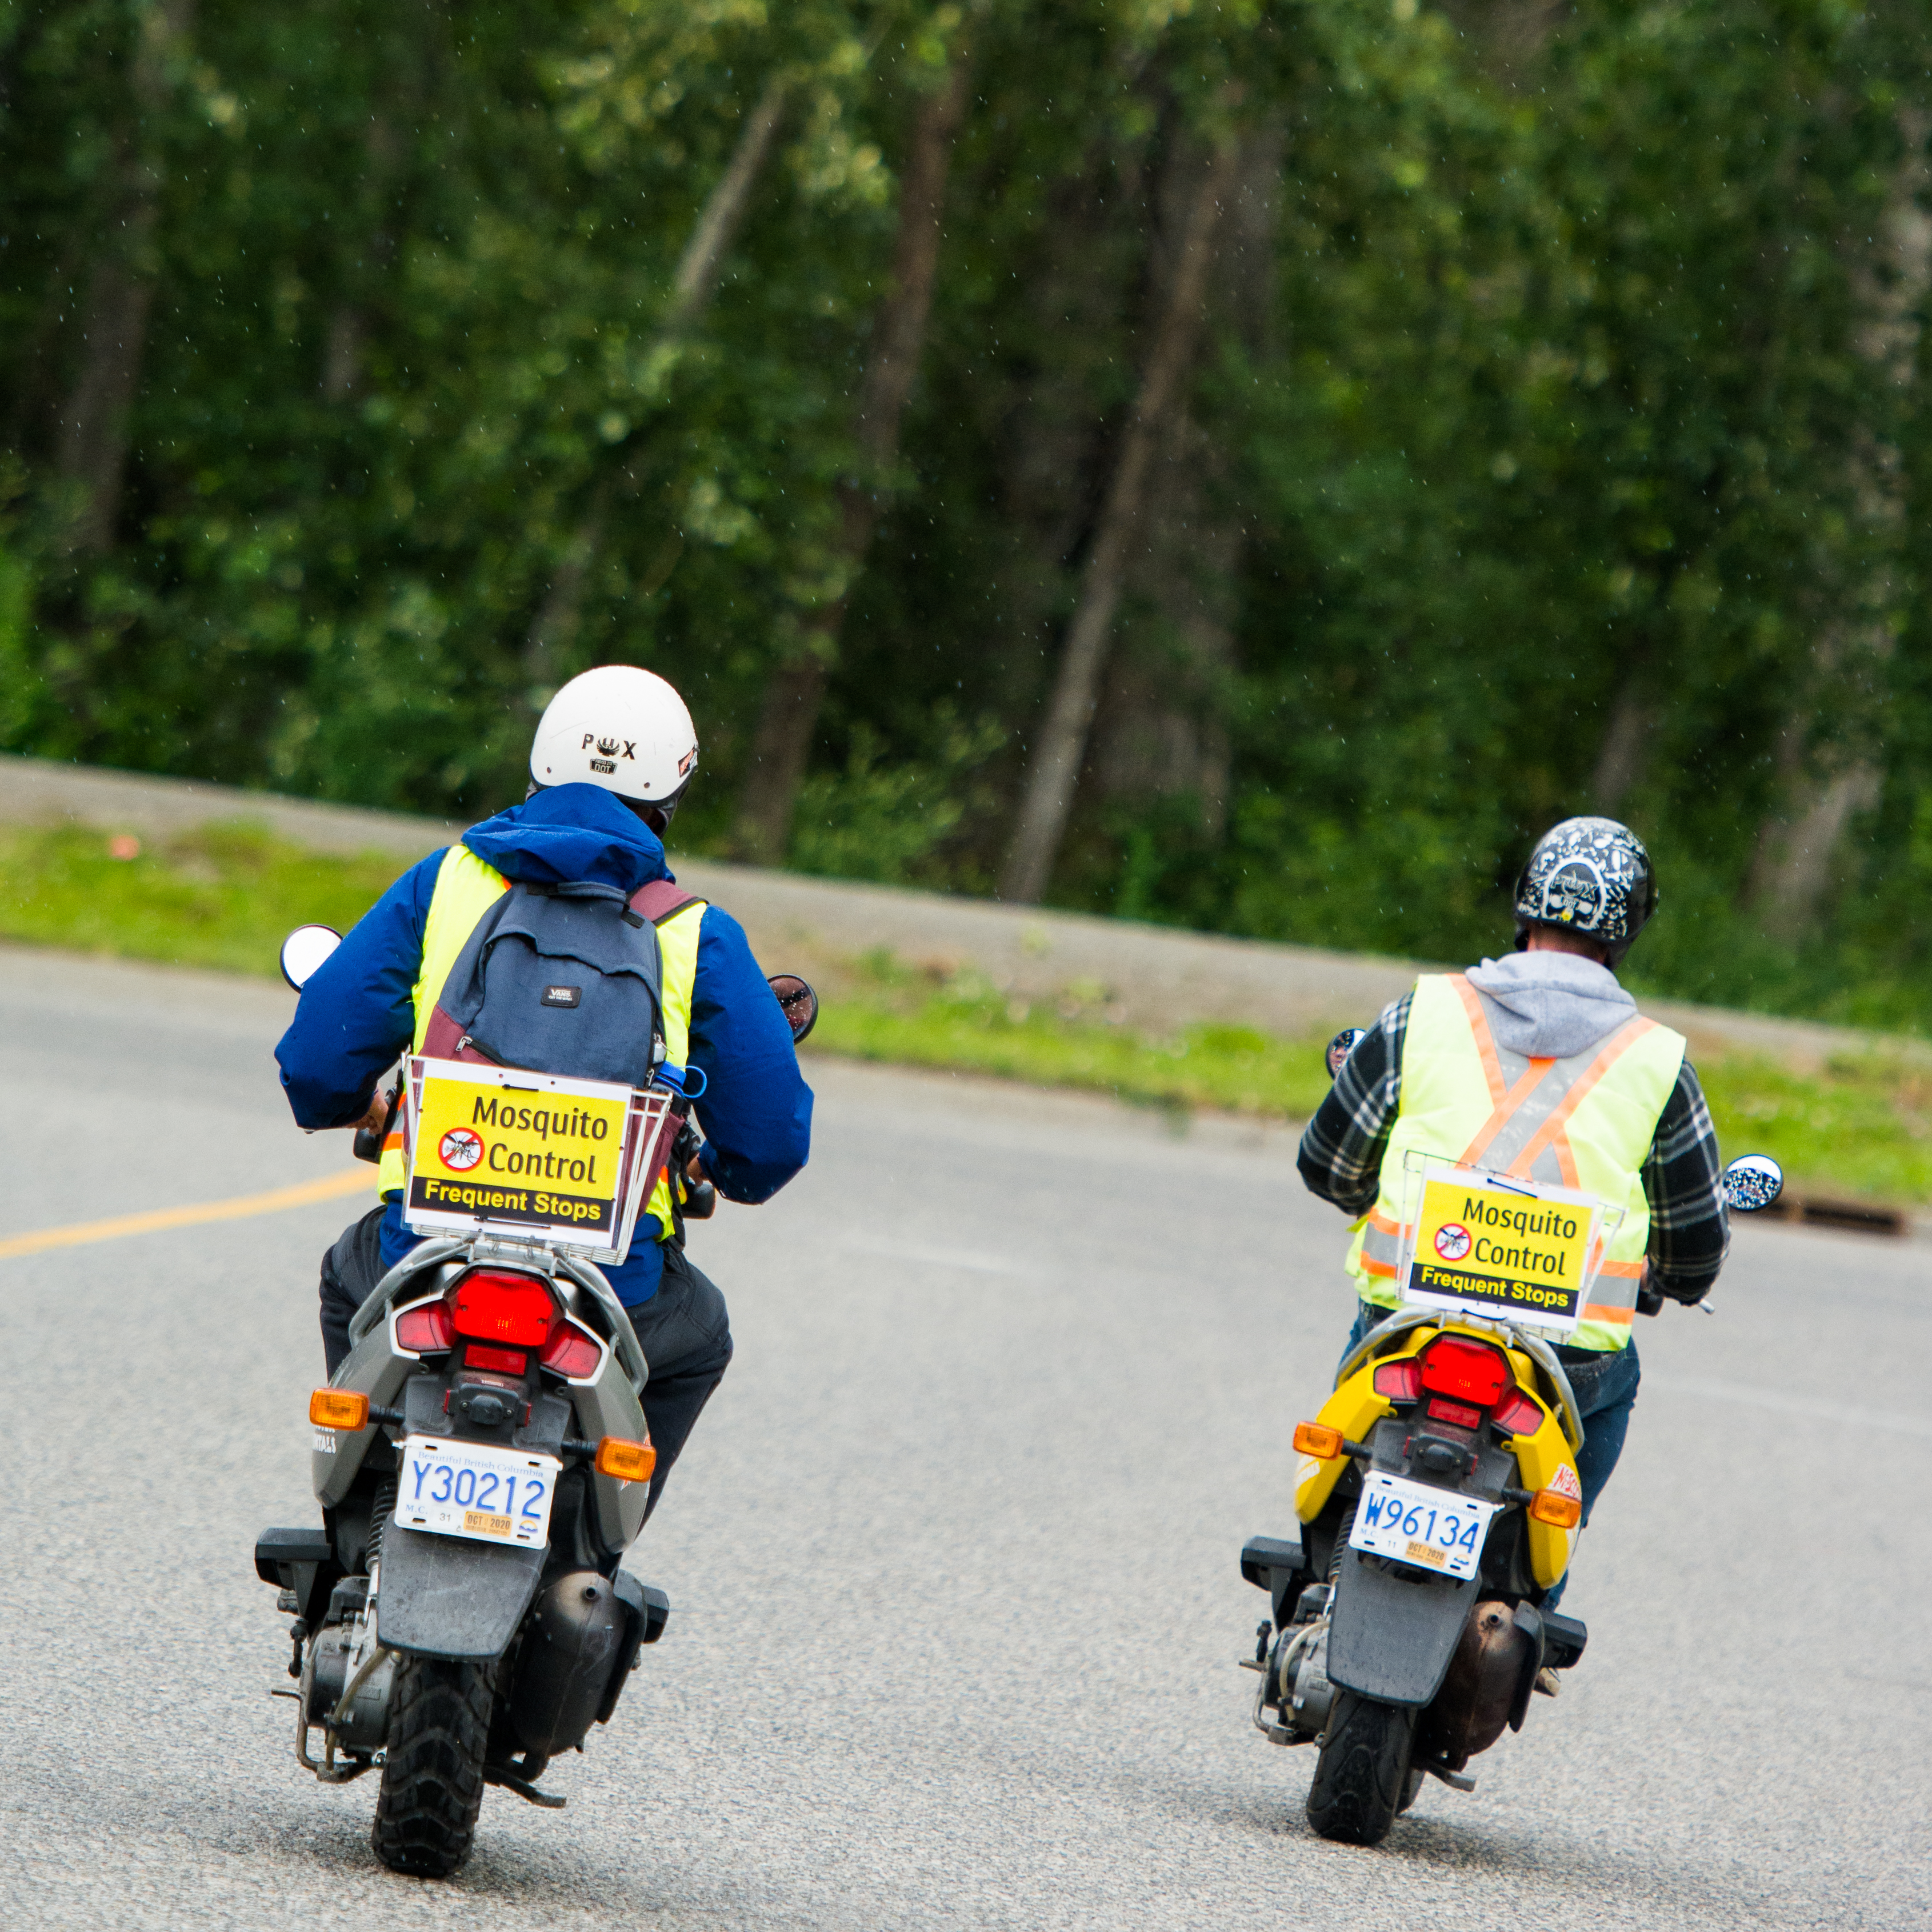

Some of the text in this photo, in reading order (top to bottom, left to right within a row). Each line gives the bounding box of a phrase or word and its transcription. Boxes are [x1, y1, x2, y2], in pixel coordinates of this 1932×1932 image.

[595, 764, 611, 773] DOT
[551, 989, 571, 997] VANS
[471, 1096, 608, 1141] Mosquito
[489, 1142, 597, 1183] Control
[425, 1179, 601, 1222] Frequent Stops
[1462, 1198, 1577, 1239] Mosquito
[1475, 1237, 1566, 1276] Control
[1421, 1266, 1569, 1307] Frequent Stops
[418, 1451, 543, 1478] Beautiful British Columbia
[413, 1460, 545, 1520] Y30212
[1376, 1485, 1480, 1519] Beautiful British Columbia
[405, 1504, 428, 1514] M.C.
[439, 1513, 451, 1522] 31
[467, 1514, 483, 1525] OCT
[490, 1518, 511, 1530] 2020
[1365, 1492, 1479, 1554] W96134
[1359, 1527, 1379, 1539] M.C.
[1387, 1540, 1397, 1549] 11
[1409, 1542, 1422, 1553] OCT
[1427, 1549, 1445, 1561] 2020
